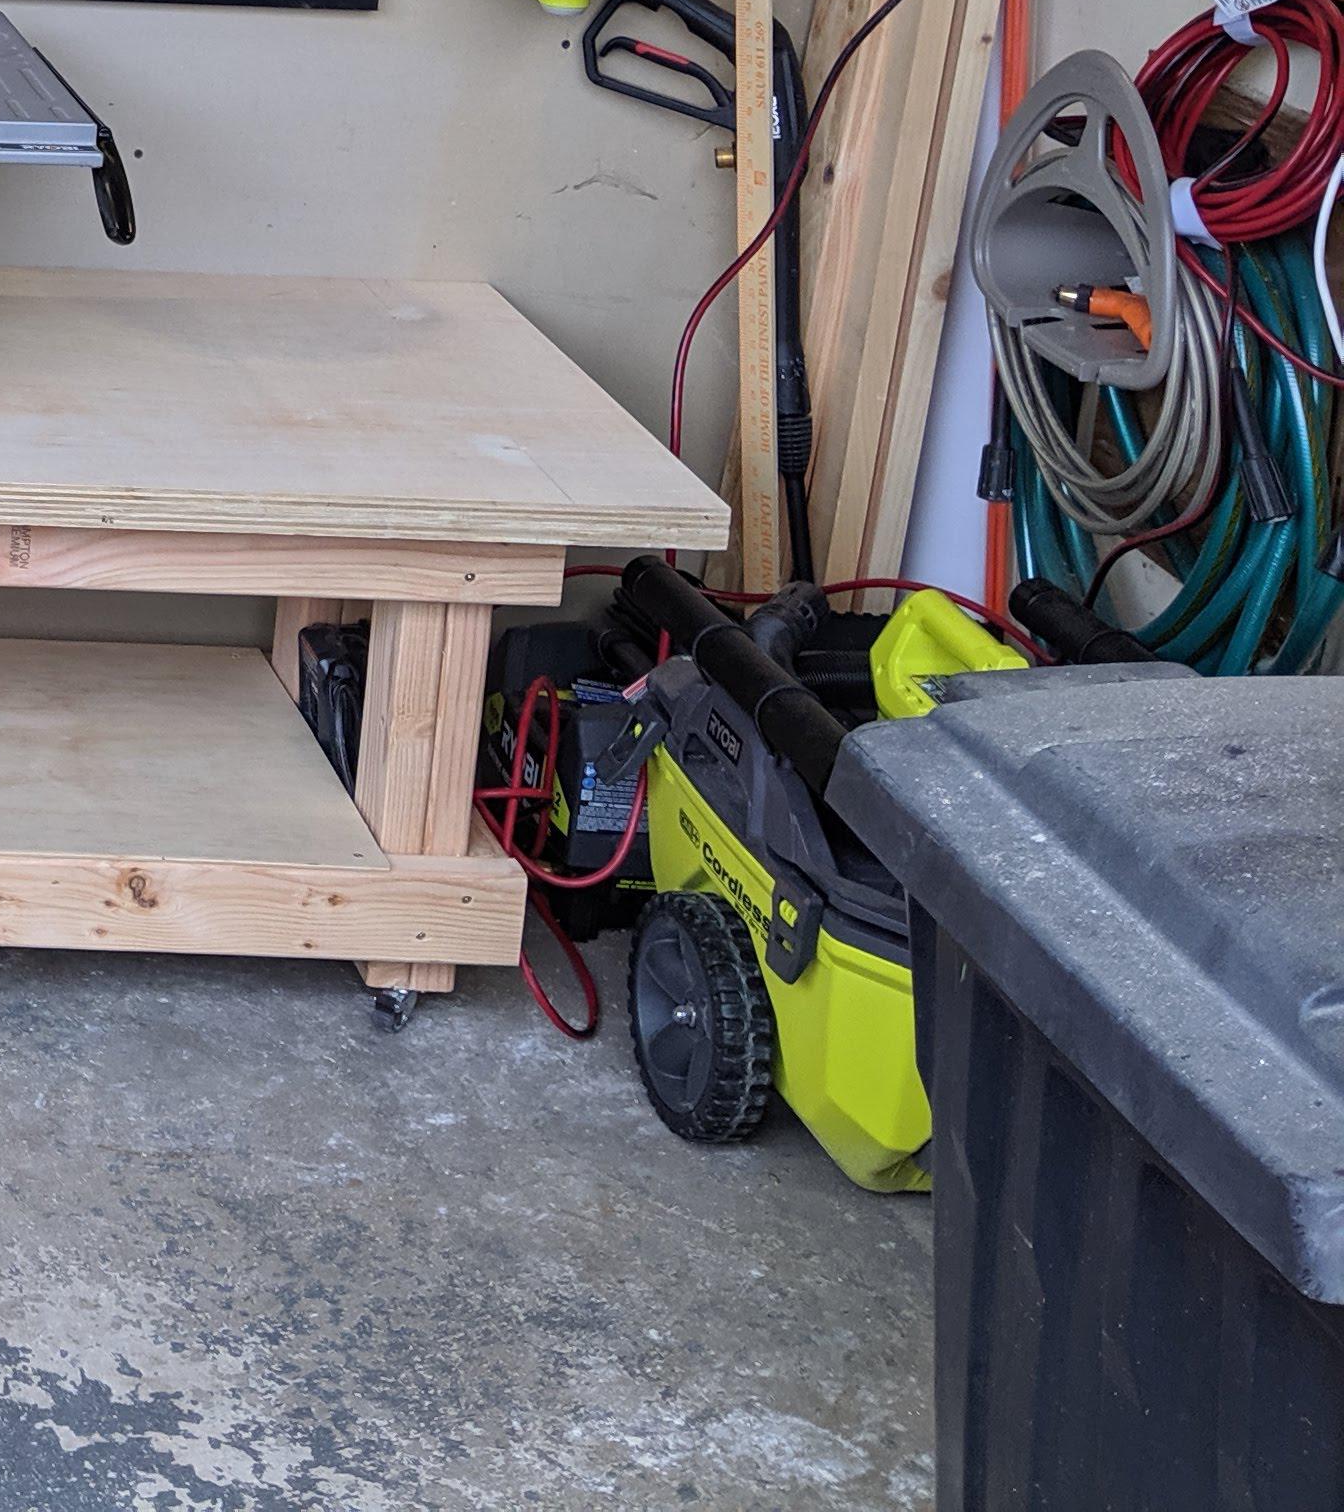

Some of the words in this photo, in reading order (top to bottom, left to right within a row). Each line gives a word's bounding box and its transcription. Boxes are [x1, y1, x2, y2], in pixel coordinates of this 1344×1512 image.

[19, 524, 32, 569] MPTON
[760, 493, 773, 550] DEPOT
[501, 720, 540, 790] RYBI
[710, 711, 741, 761] RYOBI
[702, 841, 772, 932] Cordless
